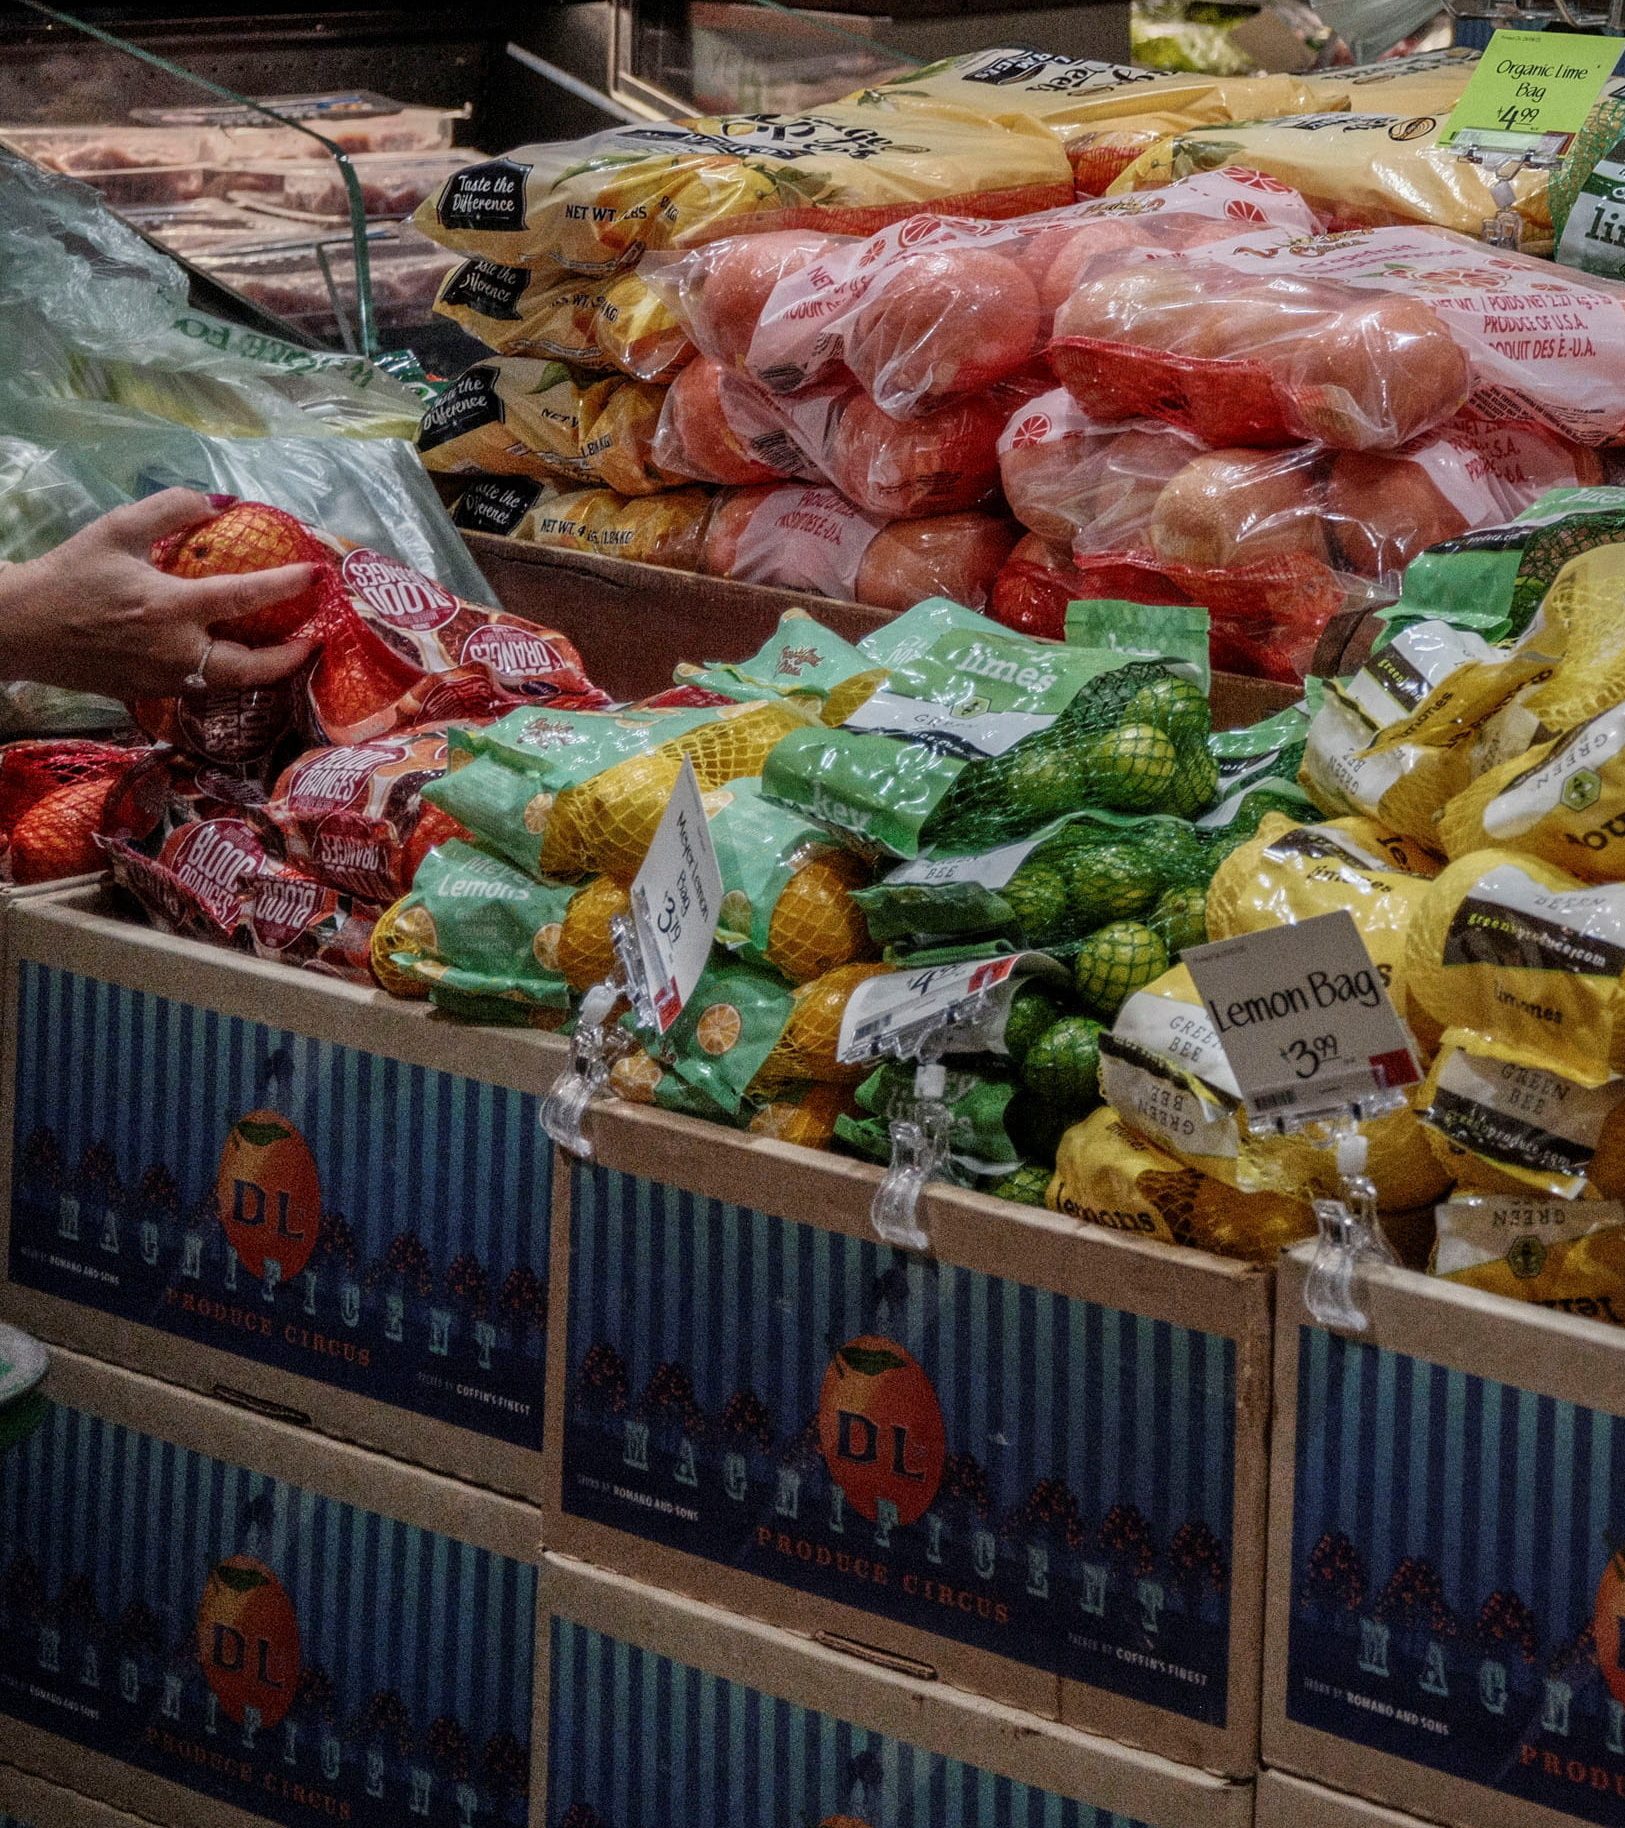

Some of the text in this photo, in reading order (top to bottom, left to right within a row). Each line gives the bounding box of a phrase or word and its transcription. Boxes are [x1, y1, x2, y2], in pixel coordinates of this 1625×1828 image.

[1496, 59, 1589, 82] Organic Lime
[1514, 81, 1546, 103] Bag
[457, 174, 515, 195] Taste the
[452, 190, 516, 213] Difference
[565, 204, 588, 219] NET
[436, 875, 531, 901] Lemons
[1209, 967, 1380, 1034] Lemon Bag
[233, 1178, 304, 1242] DL
[835, 1411, 927, 1482] DL
[756, 1525, 1012, 1625] PRODUCE CIRCUS
